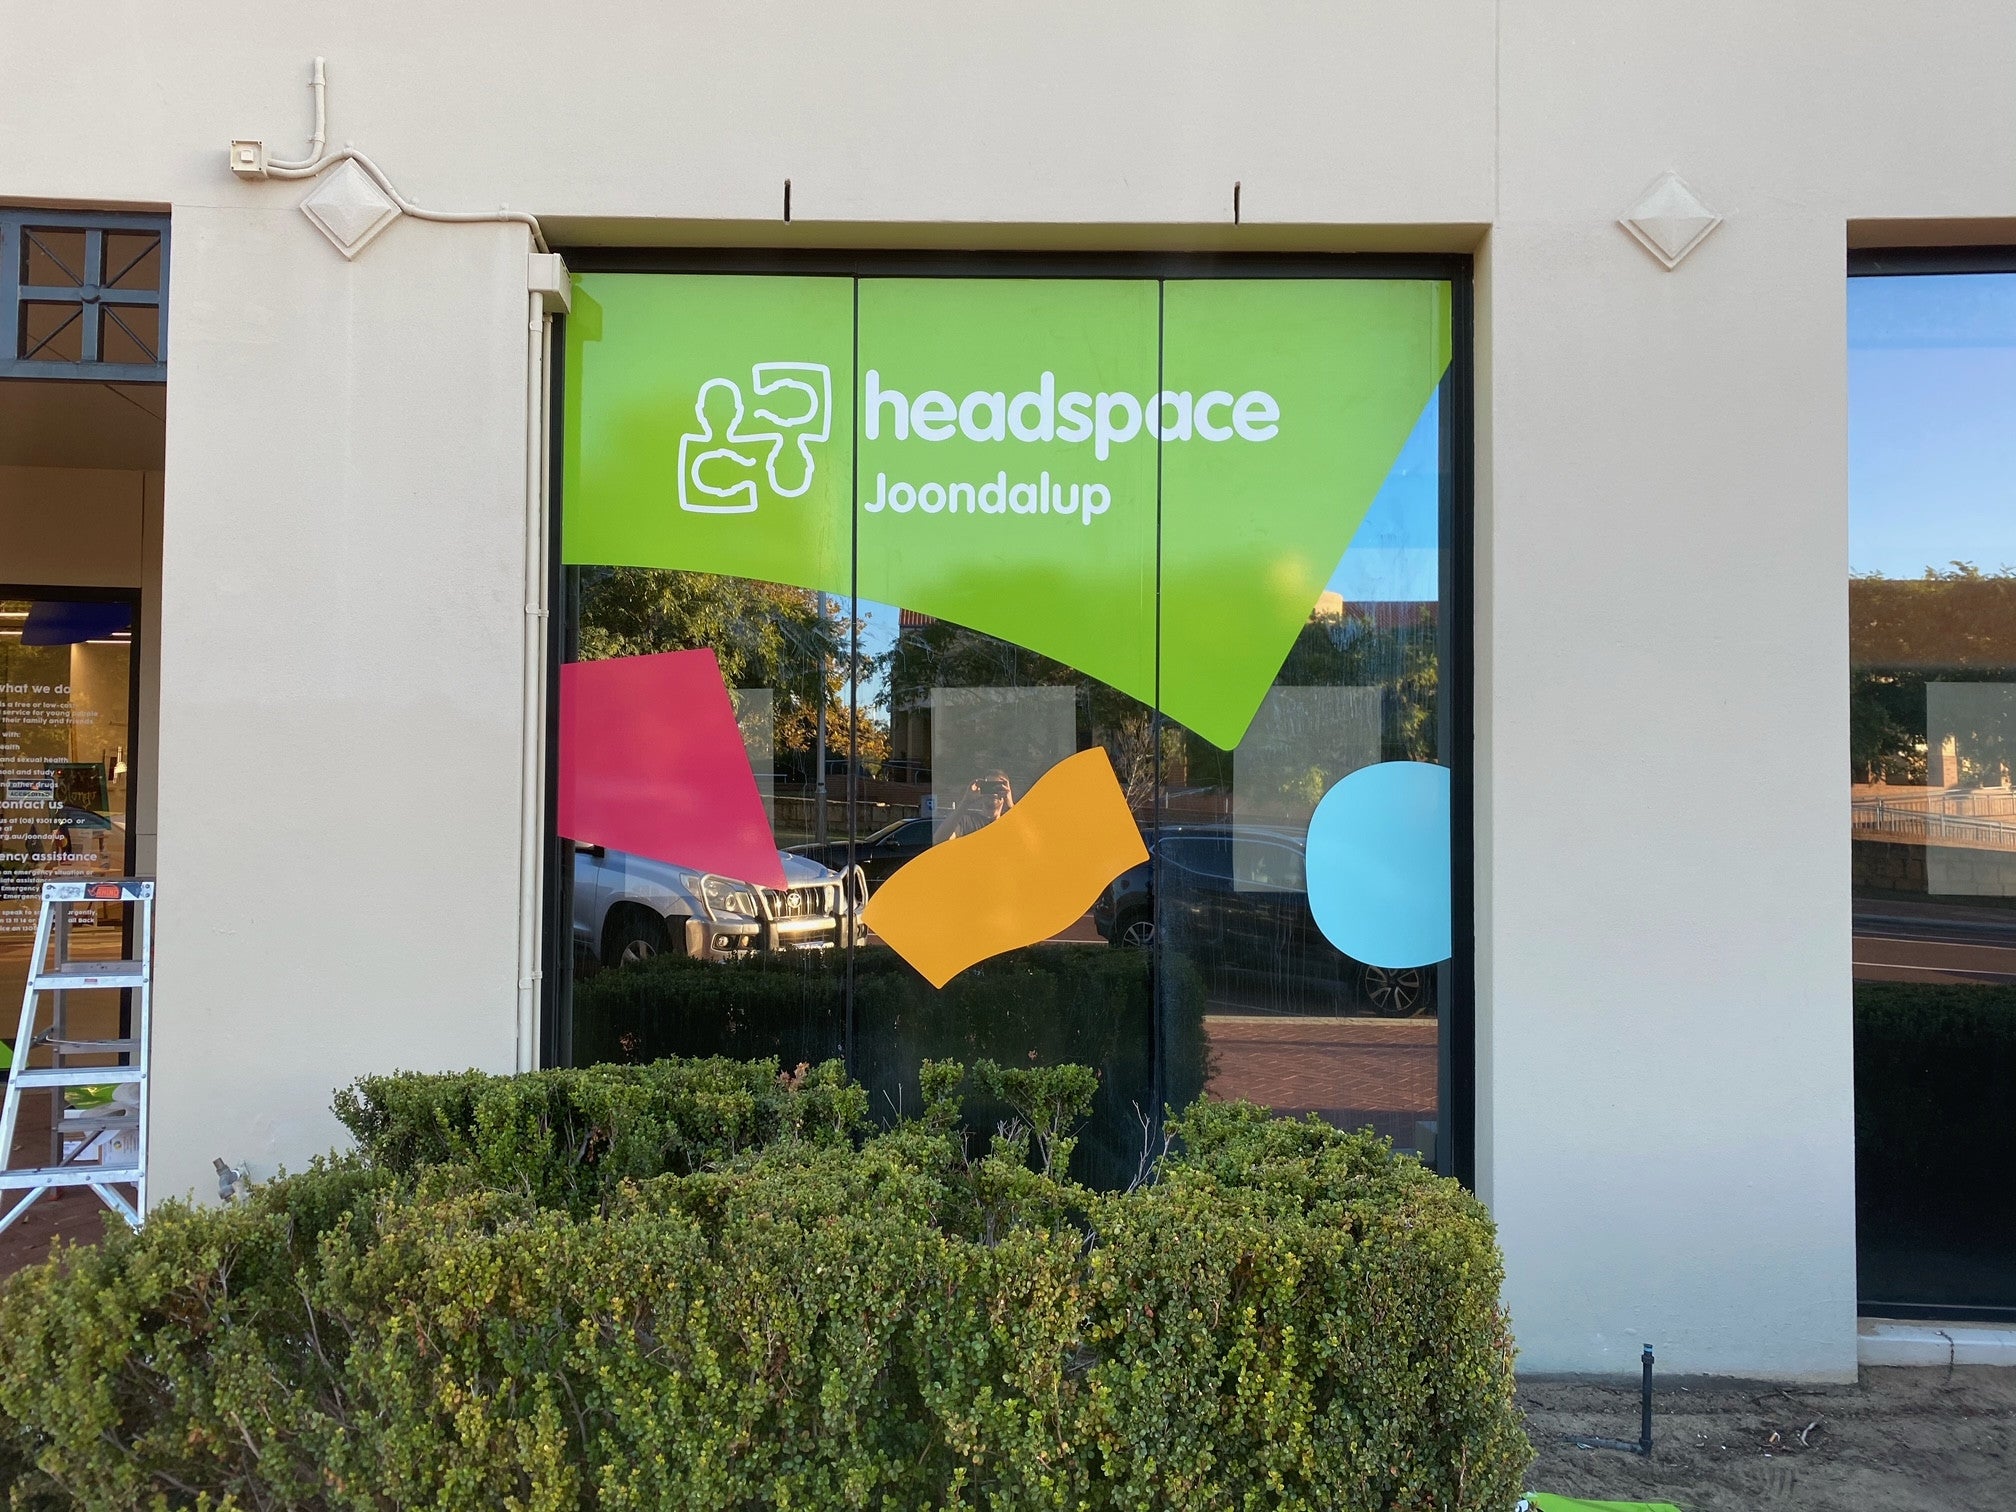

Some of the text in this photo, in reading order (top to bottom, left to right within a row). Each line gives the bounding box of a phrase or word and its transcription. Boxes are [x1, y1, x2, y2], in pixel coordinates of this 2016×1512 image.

[865, 369, 1280, 461] headspace
[864, 470, 1111, 525] Joondalup
[32, 685, 50, 694] we
[54, 684, 72, 694] do
[22, 717, 48, 725] family
[48, 802, 64, 810] us
[31, 852, 98, 862] assistance
